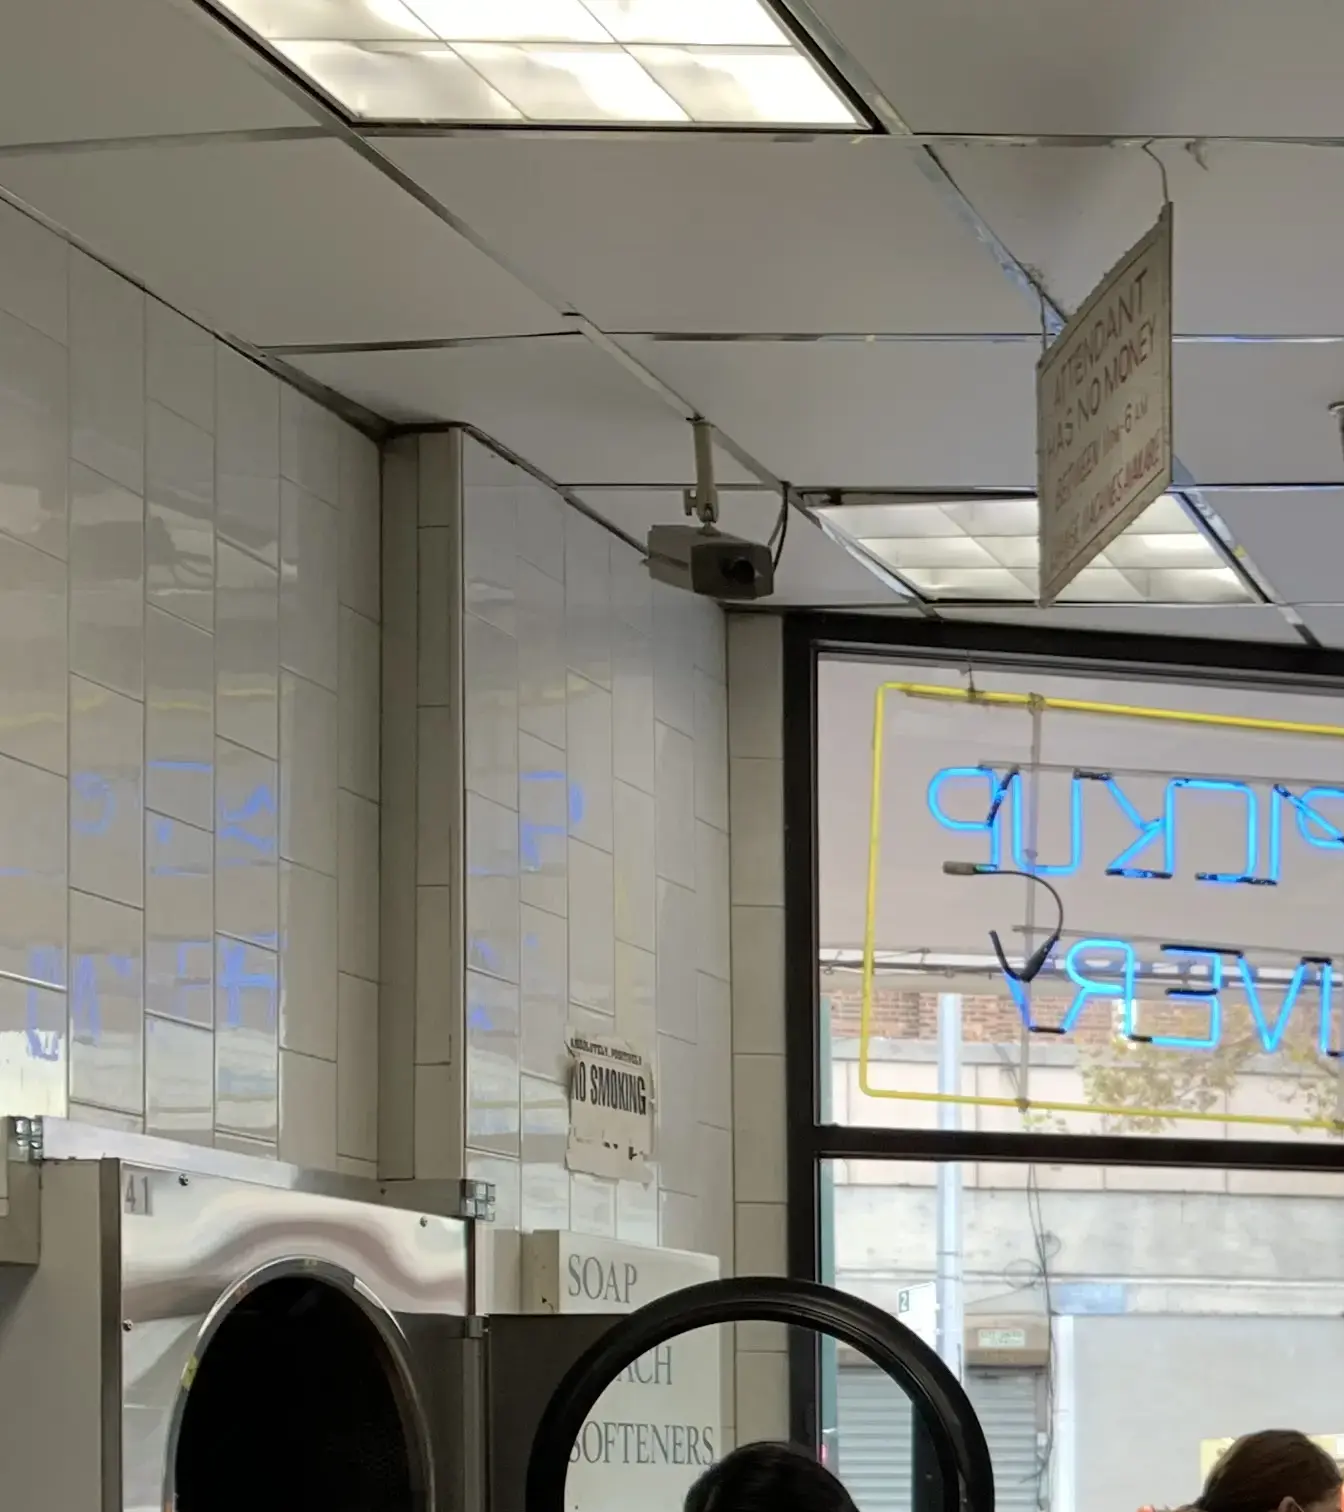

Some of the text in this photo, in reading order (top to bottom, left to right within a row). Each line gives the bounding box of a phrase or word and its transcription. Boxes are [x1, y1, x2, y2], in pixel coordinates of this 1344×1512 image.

[1053, 269, 1148, 407] ATTENDANT
[1077, 376, 1101, 430] NO
[589, 1064, 647, 1116] SMOKING
[125, 1174, 148, 1215] 41
[568, 1254, 638, 1304] SOAP
[569, 1420, 715, 1466] SOFTENERS
